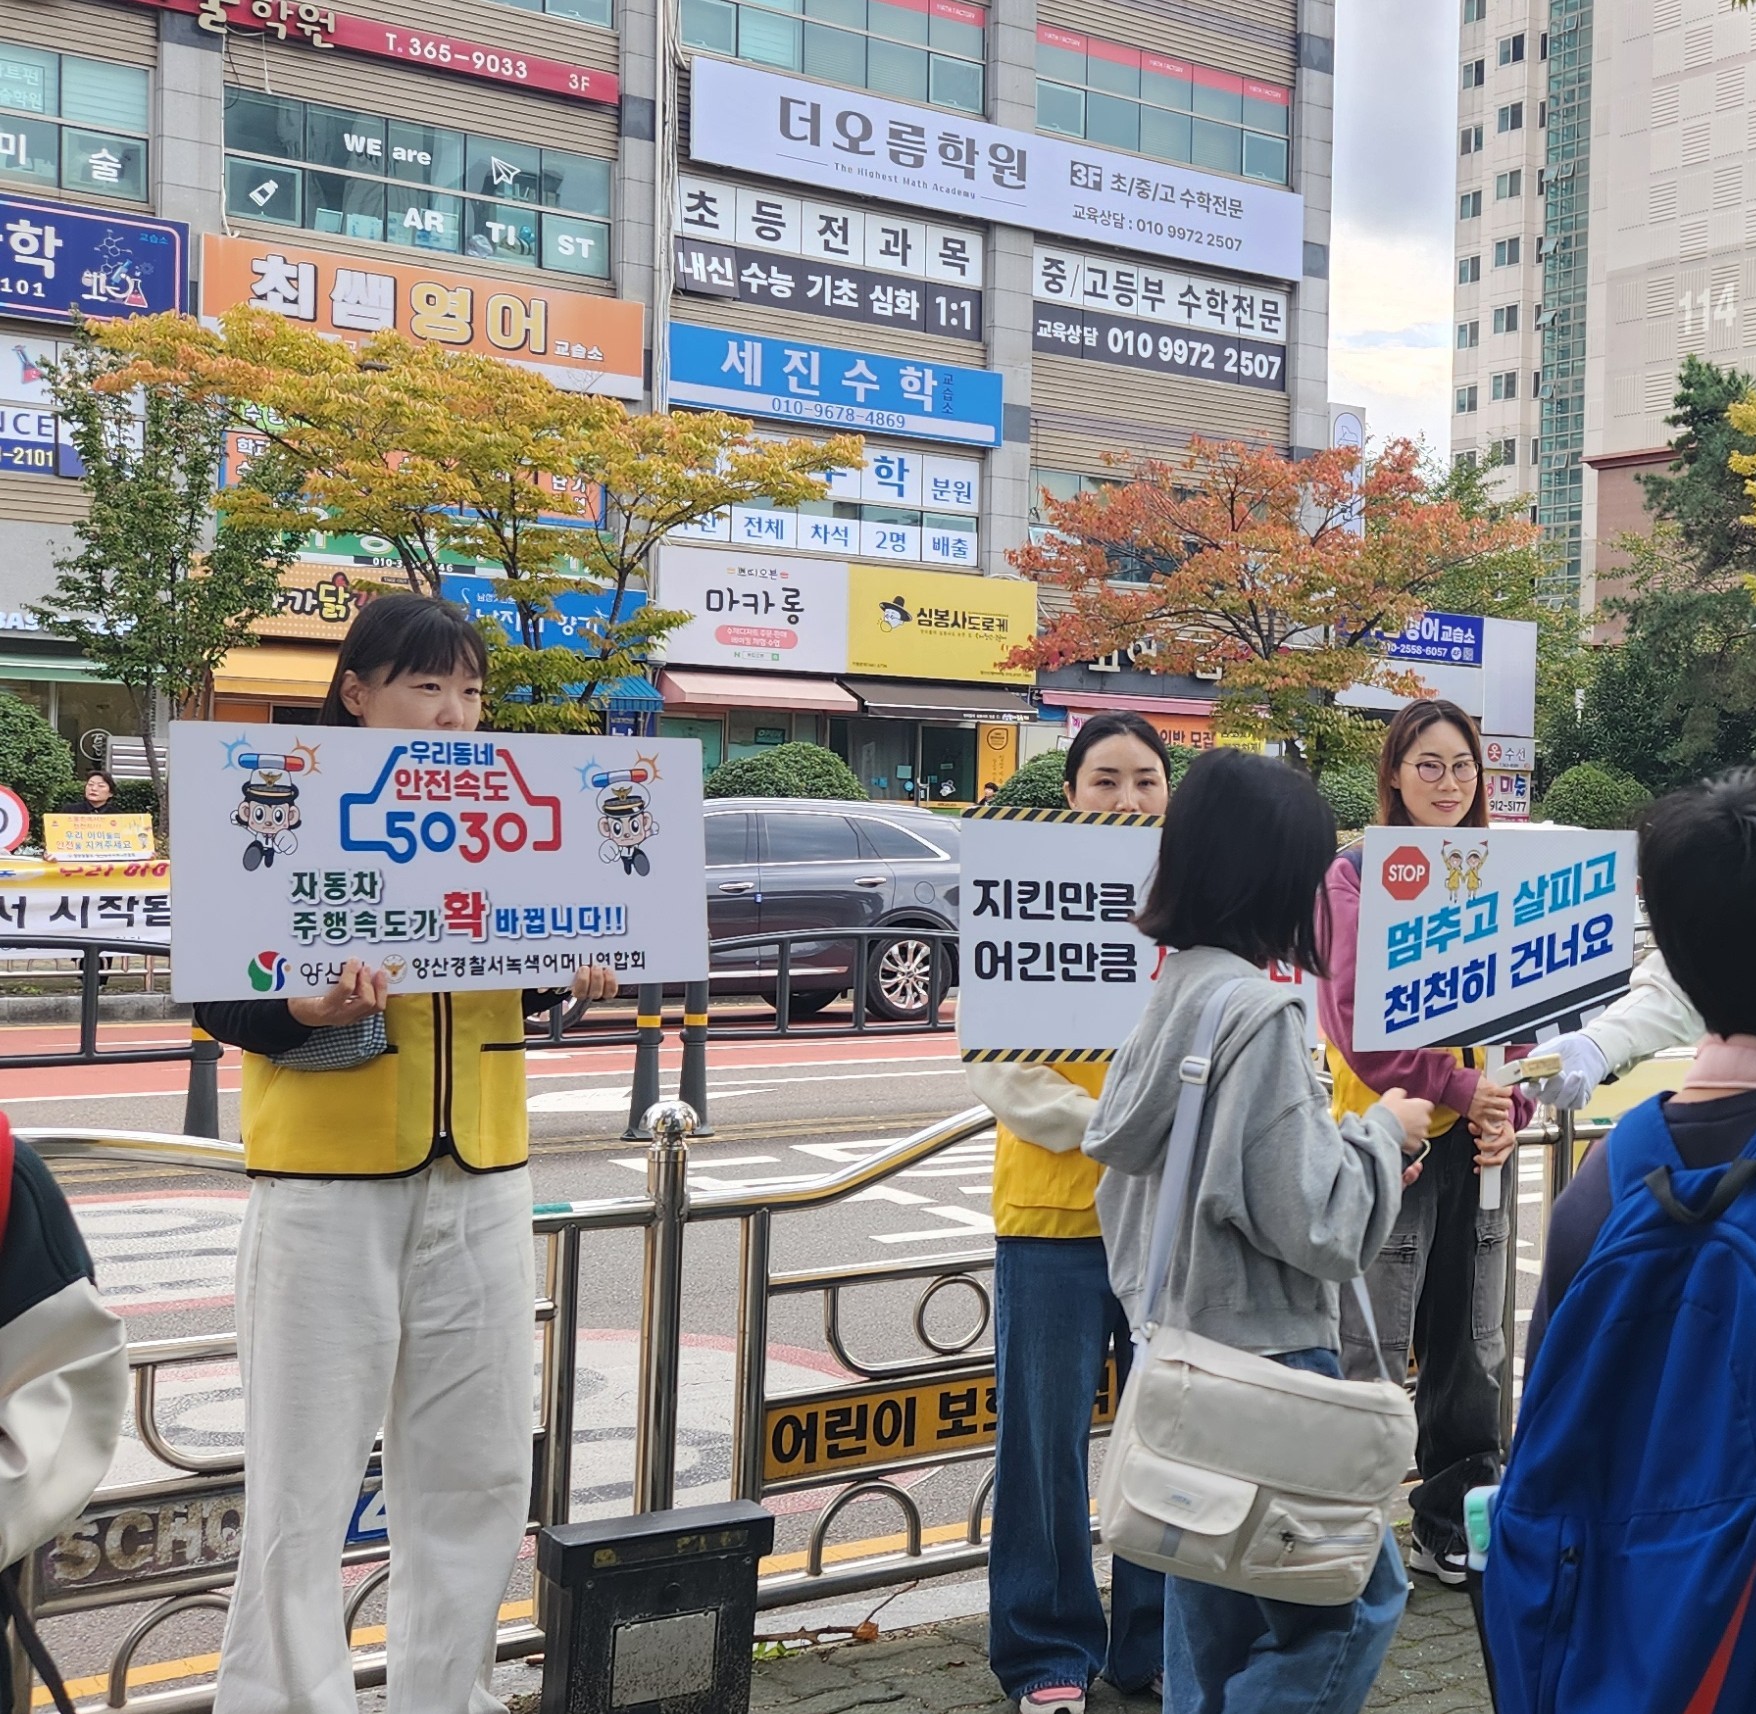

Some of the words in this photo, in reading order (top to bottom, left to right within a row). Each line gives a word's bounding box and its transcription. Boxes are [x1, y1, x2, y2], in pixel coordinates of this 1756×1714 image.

[385, 32, 402, 53] T.
[408, 38, 528, 79] 365-9033
[568, 73, 591, 92] 3F
[344, 133, 383, 157] WE
[392, 145, 432, 166] are
[779, 95, 1027, 190] 더오름학원
[834, 162, 853, 175] The
[857, 167, 899, 184] Highest
[902, 176, 929, 189] Math
[932, 183, 976, 199] Academy
[1070, 160, 1102, 191] 3F
[1110, 172, 1176, 203] 초/중/고
[1179, 188, 1244, 220] 수학전문
[1072, 204, 1125, 230] 교육상담
[1136, 218, 1164, 236] 010
[1167, 225, 1203, 245] 9972
[1206, 233, 1243, 251] 2507
[677, 250, 735, 288] 내신
[740, 261, 796, 299] 수능
[806, 274, 860, 308] 기초
[868, 285, 920, 321] 심화
[935, 295, 971, 331] 1:1
[1041, 256, 1166, 313] 중/고등부
[1177, 284, 1282, 335] 수학전문
[1679, 283, 1736, 335] 114
[554, 340, 604, 362] 교습소
[1037, 319, 1099, 347] 교육상담
[1107, 327, 1154, 358] 010
[1158, 336, 1215, 370] 9972
[1223, 347, 1282, 380] 2507
[720, 339, 938, 412] 세진수학
[772, 396, 906, 429] 010-9678-4869
[931, 476, 972, 505] 분원
[744, 515, 784, 541] 전체
[810, 523, 849, 547] 차석
[875, 529, 906, 553] 2명
[932, 535, 969, 560] 배출
[705, 586, 805, 625] 마카롱
[916, 607, 1009, 633] 심봉사도로케
[410, 741, 495, 766] 우리동네
[1505, 748, 1526, 762] 수선
[394, 769, 510, 802] 안전속도
[386, 811, 528, 864] 5030
[291, 870, 379, 901] 자동차
[1388, 864, 1426, 882] STOP
[293, 909, 437, 940] 주행속도가
[443, 890, 486, 938] 확
[972, 879, 1137, 922] 지킨만큼
[1388, 891, 1499, 971] 멈추고
[1512, 851, 1617, 927] 살피고
[973, 940, 1138, 983] 어긴만큼
[1384, 953, 1497, 1034] 천천히
[1510, 913, 1614, 989] 건너요
[772, 1397, 917, 1463] 어린이
